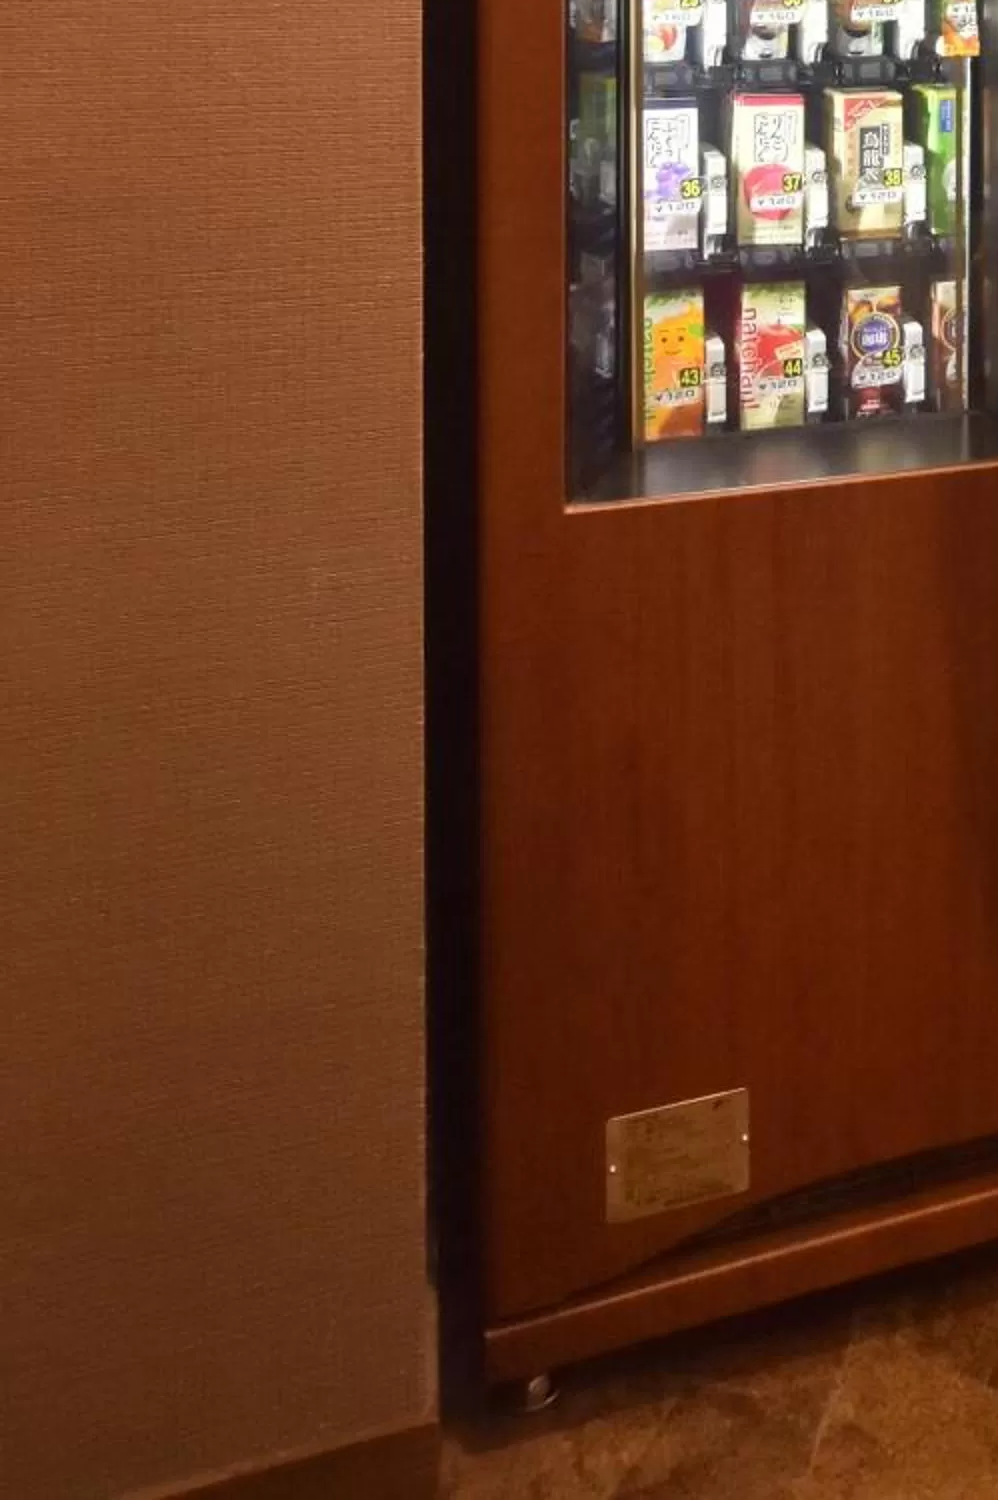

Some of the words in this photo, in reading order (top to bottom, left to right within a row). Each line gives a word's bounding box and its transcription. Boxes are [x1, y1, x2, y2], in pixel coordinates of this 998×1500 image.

[681, 179, 700, 197] 36
[784, 175, 801, 192] 37
[883, 349, 901, 368] 45
[680, 368, 699, 386] 43
[785, 359, 801, 377] 44
